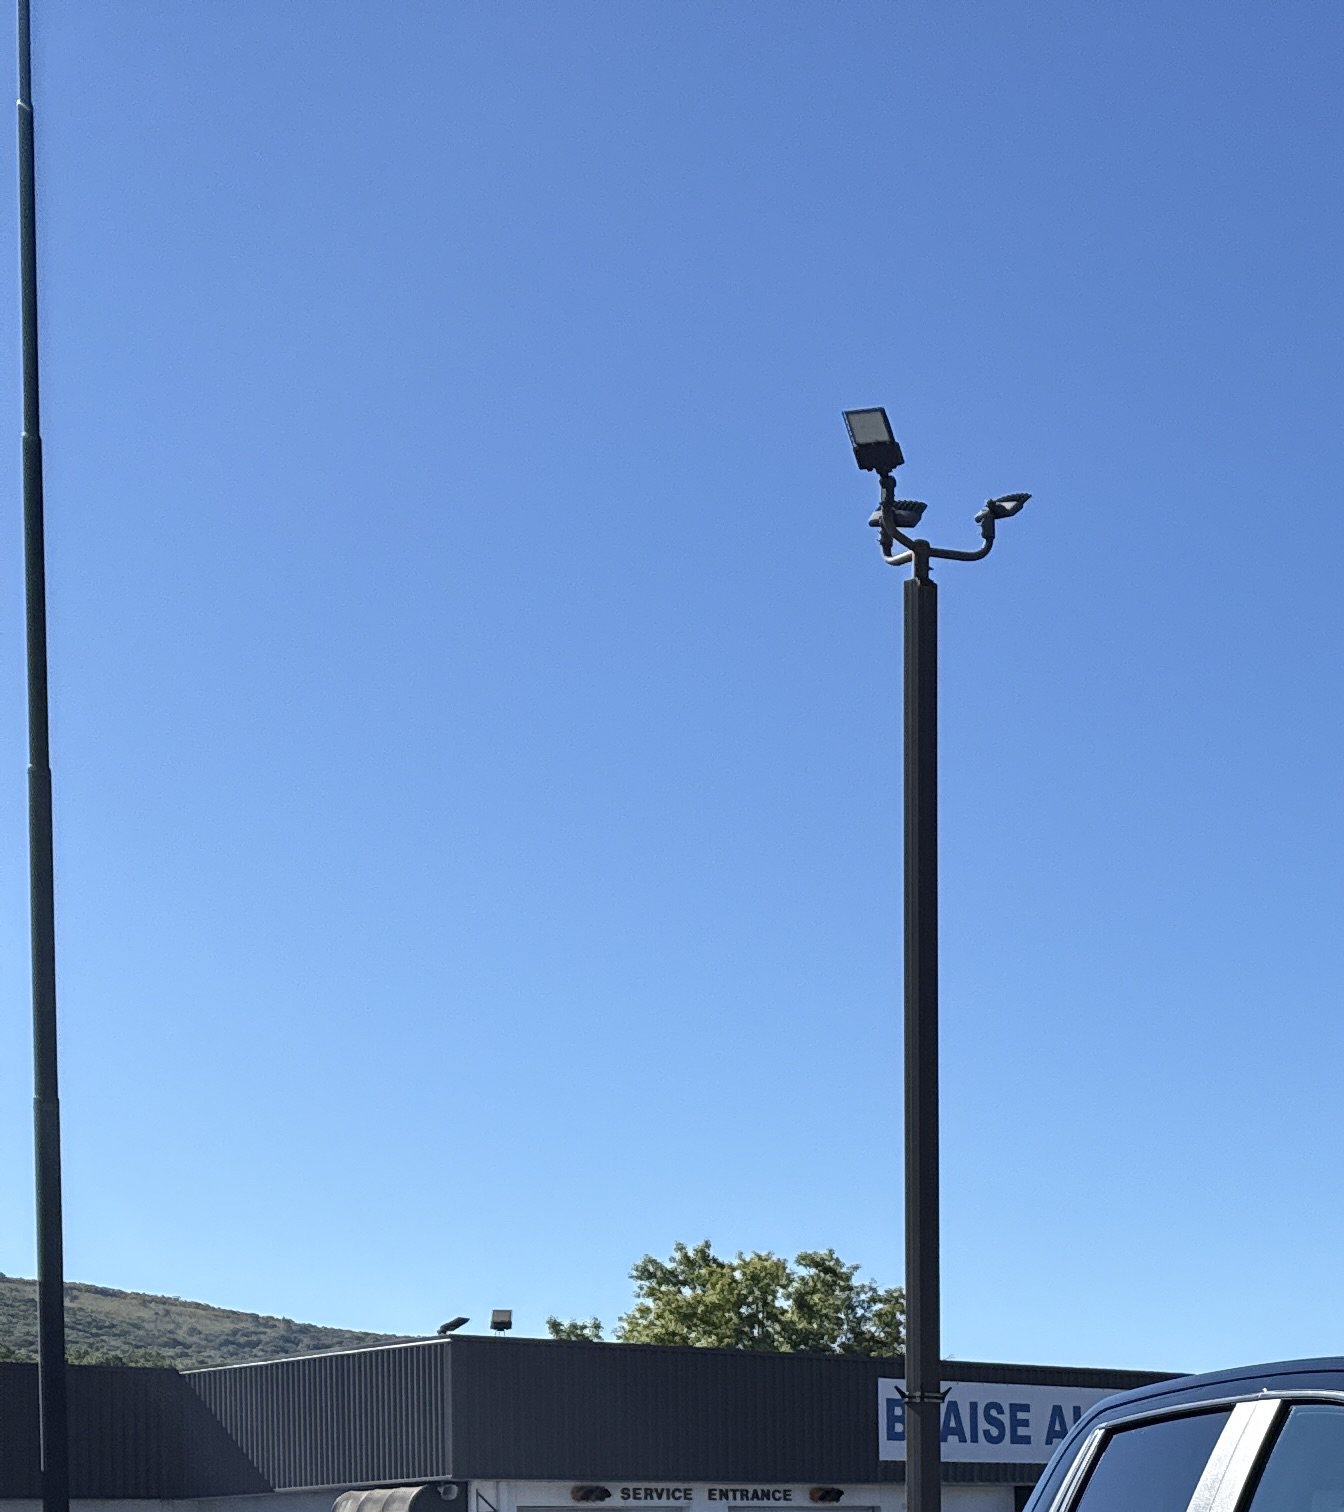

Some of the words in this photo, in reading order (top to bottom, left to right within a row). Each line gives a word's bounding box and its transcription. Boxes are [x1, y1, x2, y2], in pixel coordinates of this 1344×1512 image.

[885, 1397, 1032, 1445] BAISE
[620, 1487, 693, 1501] SERVICE
[707, 1487, 793, 1501] ENTRANCE
